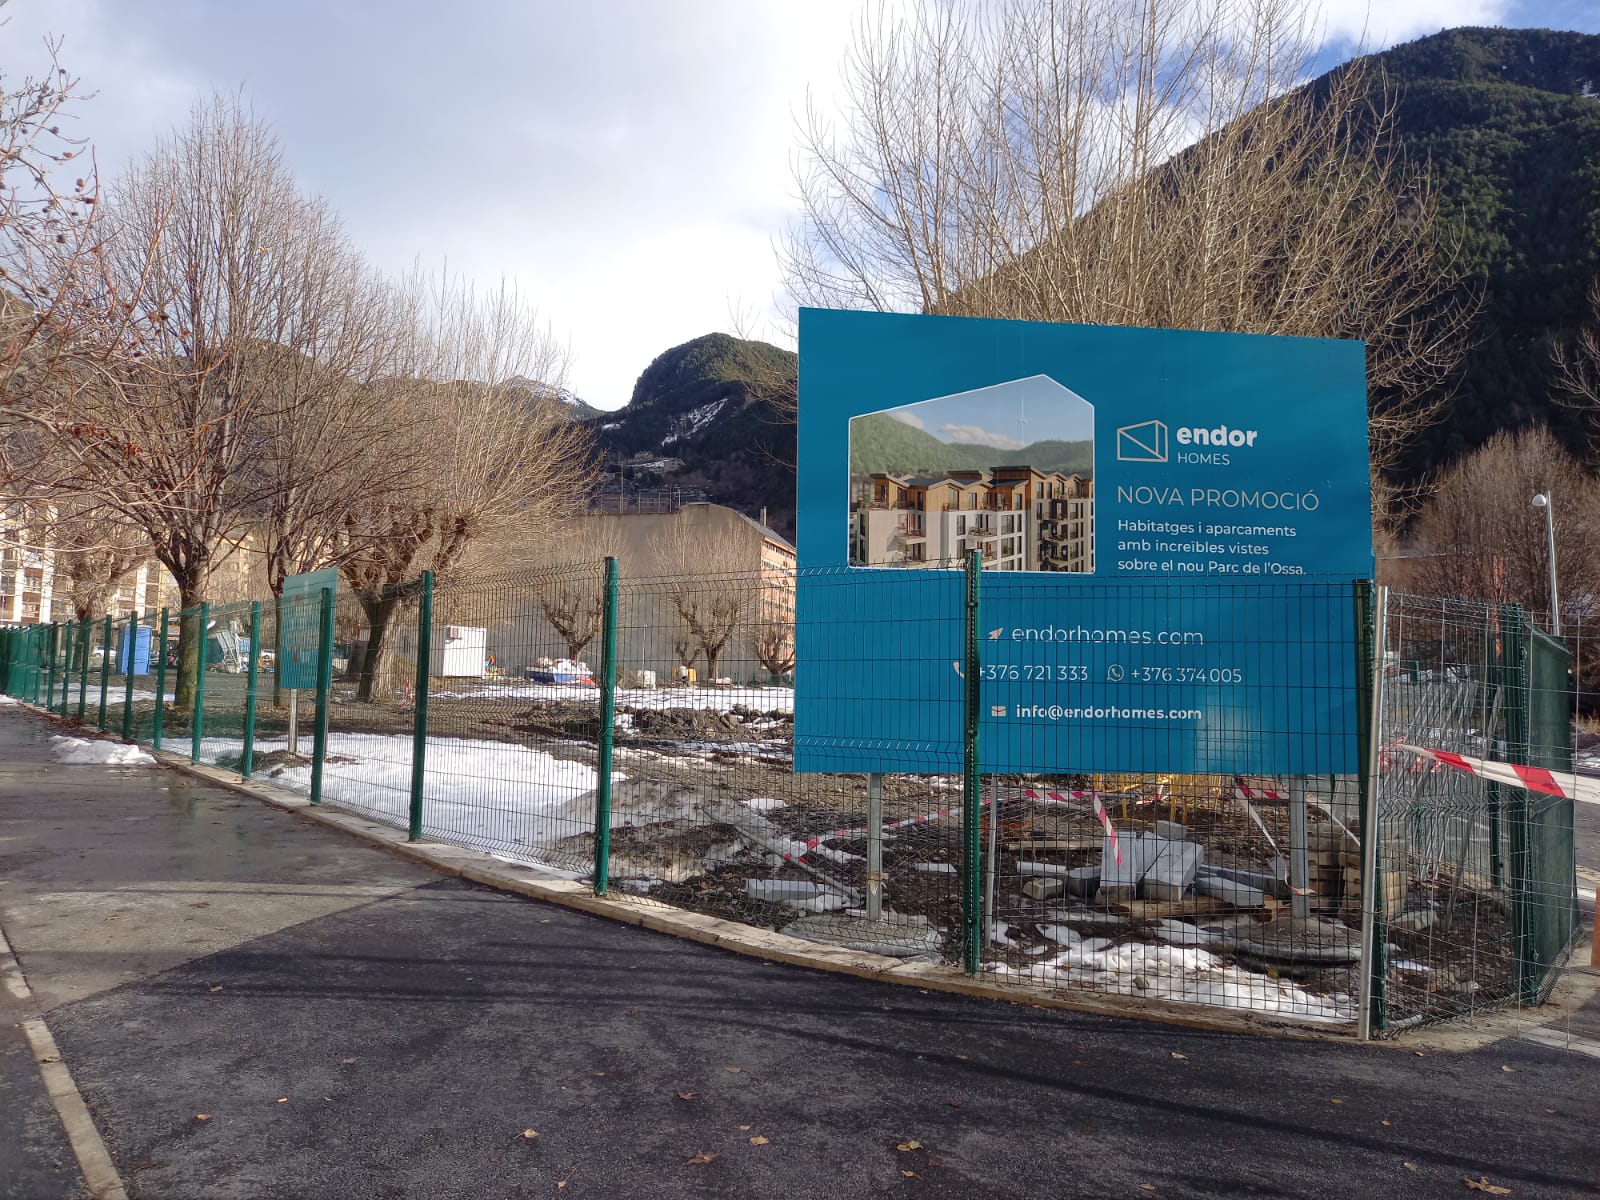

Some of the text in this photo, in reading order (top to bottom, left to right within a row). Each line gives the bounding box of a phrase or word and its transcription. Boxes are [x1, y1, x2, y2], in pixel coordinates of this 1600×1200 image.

[1176, 424, 1258, 447] endor
[1177, 452, 1230, 466] HOMES
[1117, 485, 1319, 511] NOVA PROMOCIÓ
[1118, 519, 1297, 537] Habitatges i aparcaments
[1118, 539, 1269, 555] amb increïbles vistes
[1118, 558, 1307, 575] sobre el nou Parc de l'Ossa.
[1012, 624, 1204, 646] endorhomes.com
[1023, 665, 1051, 680] 721
[1057, 665, 1088, 681] 333
[1131, 667, 1242, 683] +376 374 005
[1016, 704, 1202, 721] info@endorhomes.com
